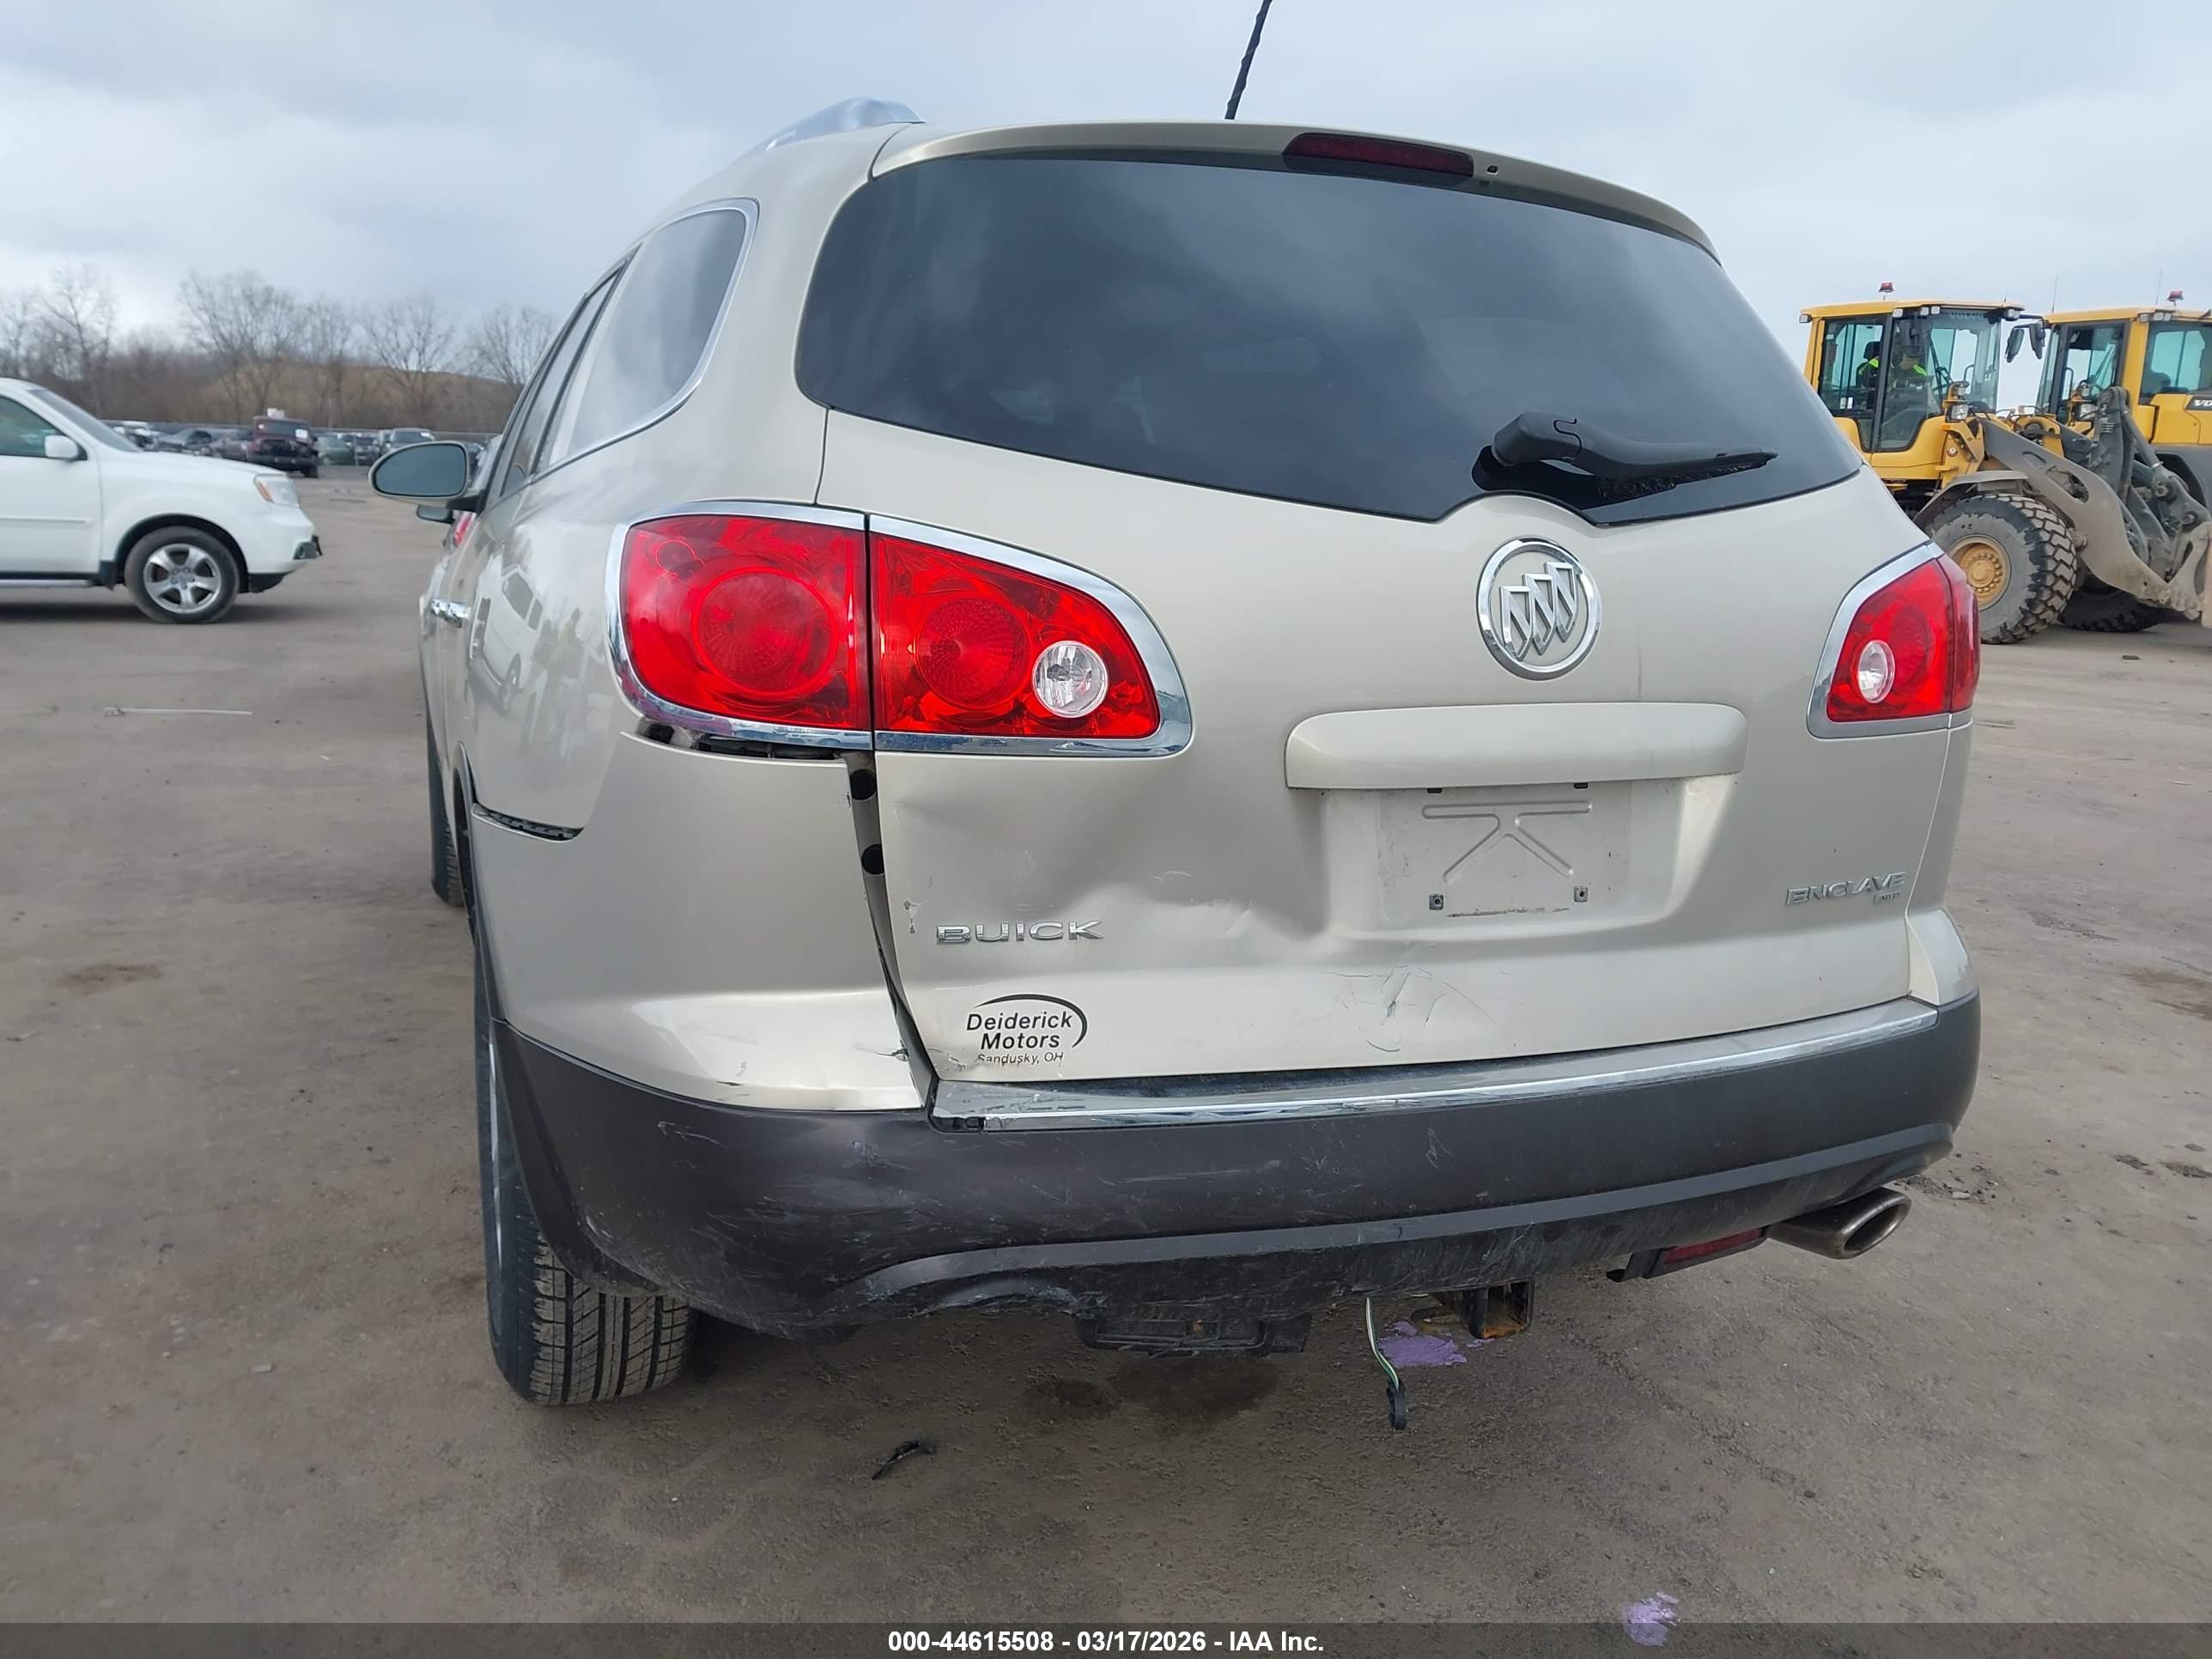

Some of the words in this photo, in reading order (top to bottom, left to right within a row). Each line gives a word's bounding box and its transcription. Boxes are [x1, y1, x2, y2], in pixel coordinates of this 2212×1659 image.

[937, 921, 1103, 943] BUICK
[967, 1012, 1073, 1030] Deiderick
[981, 1033, 1060, 1049] Motors
[977, 1054, 1040, 1065] Sandusky,
[1044, 1052, 1064, 1062] OH
